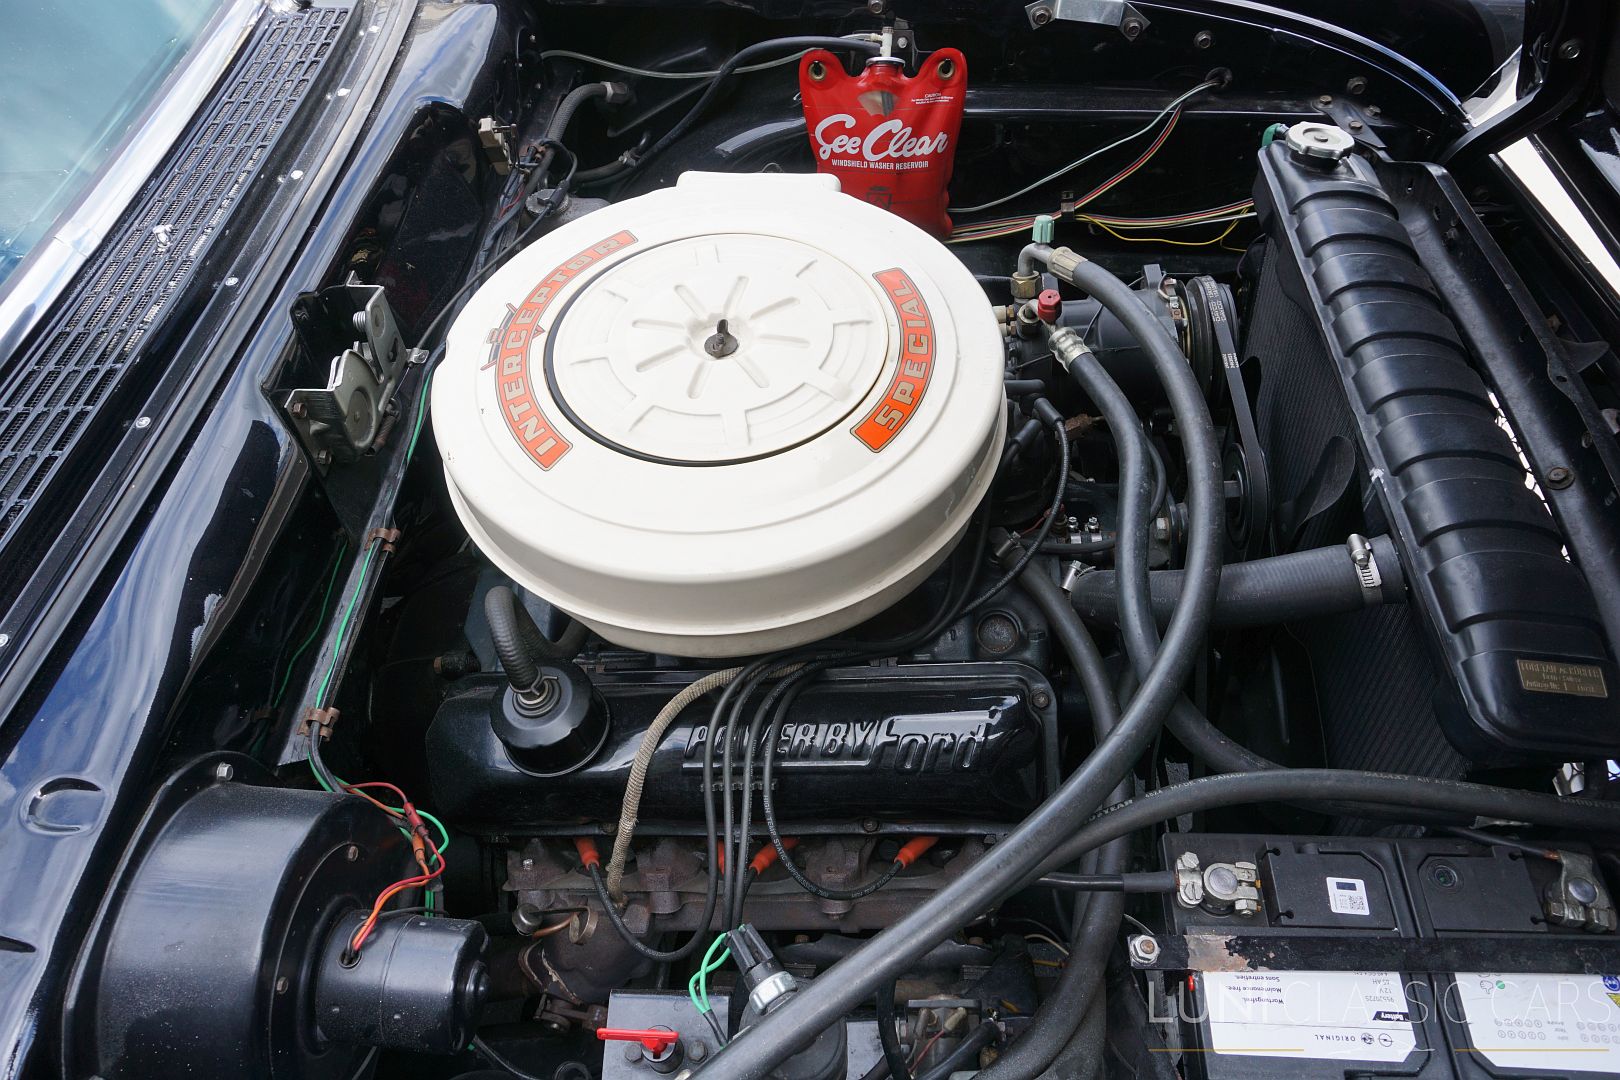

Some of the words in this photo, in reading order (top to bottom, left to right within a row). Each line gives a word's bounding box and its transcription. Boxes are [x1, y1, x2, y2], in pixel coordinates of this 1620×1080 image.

[814, 114, 862, 160] See
[862, 119, 949, 162] Clear
[831, 159, 868, 169] WINDSHIELD
[869, 161, 894, 170] WASHER
[895, 160, 929, 171] RESERVOIR
[503, 238, 621, 457] INTERCEPTOR
[874, 279, 930, 431] SPECIAL
[820, 722, 876, 757] BY
[767, 816, 777, 835] TEMP
[773, 838, 788, 861] STATIC
[1314, 1034, 1356, 1042] ORIGINAL
